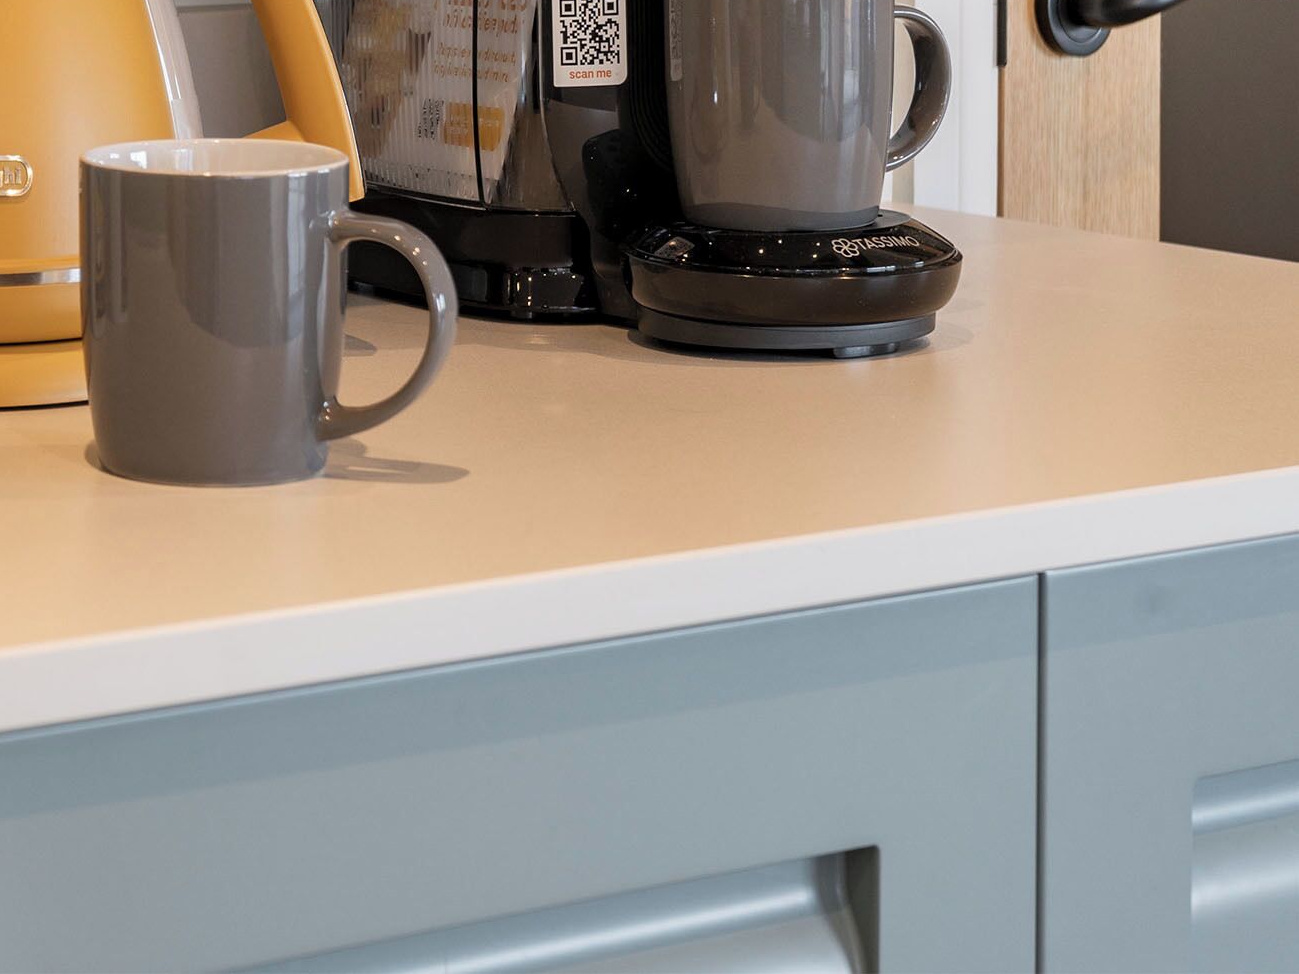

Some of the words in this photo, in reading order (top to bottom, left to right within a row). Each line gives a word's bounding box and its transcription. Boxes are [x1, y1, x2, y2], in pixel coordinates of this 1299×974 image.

[569, 69, 594, 80] scan
[596, 69, 612, 79] me
[851, 236, 920, 251] TASSIMO
